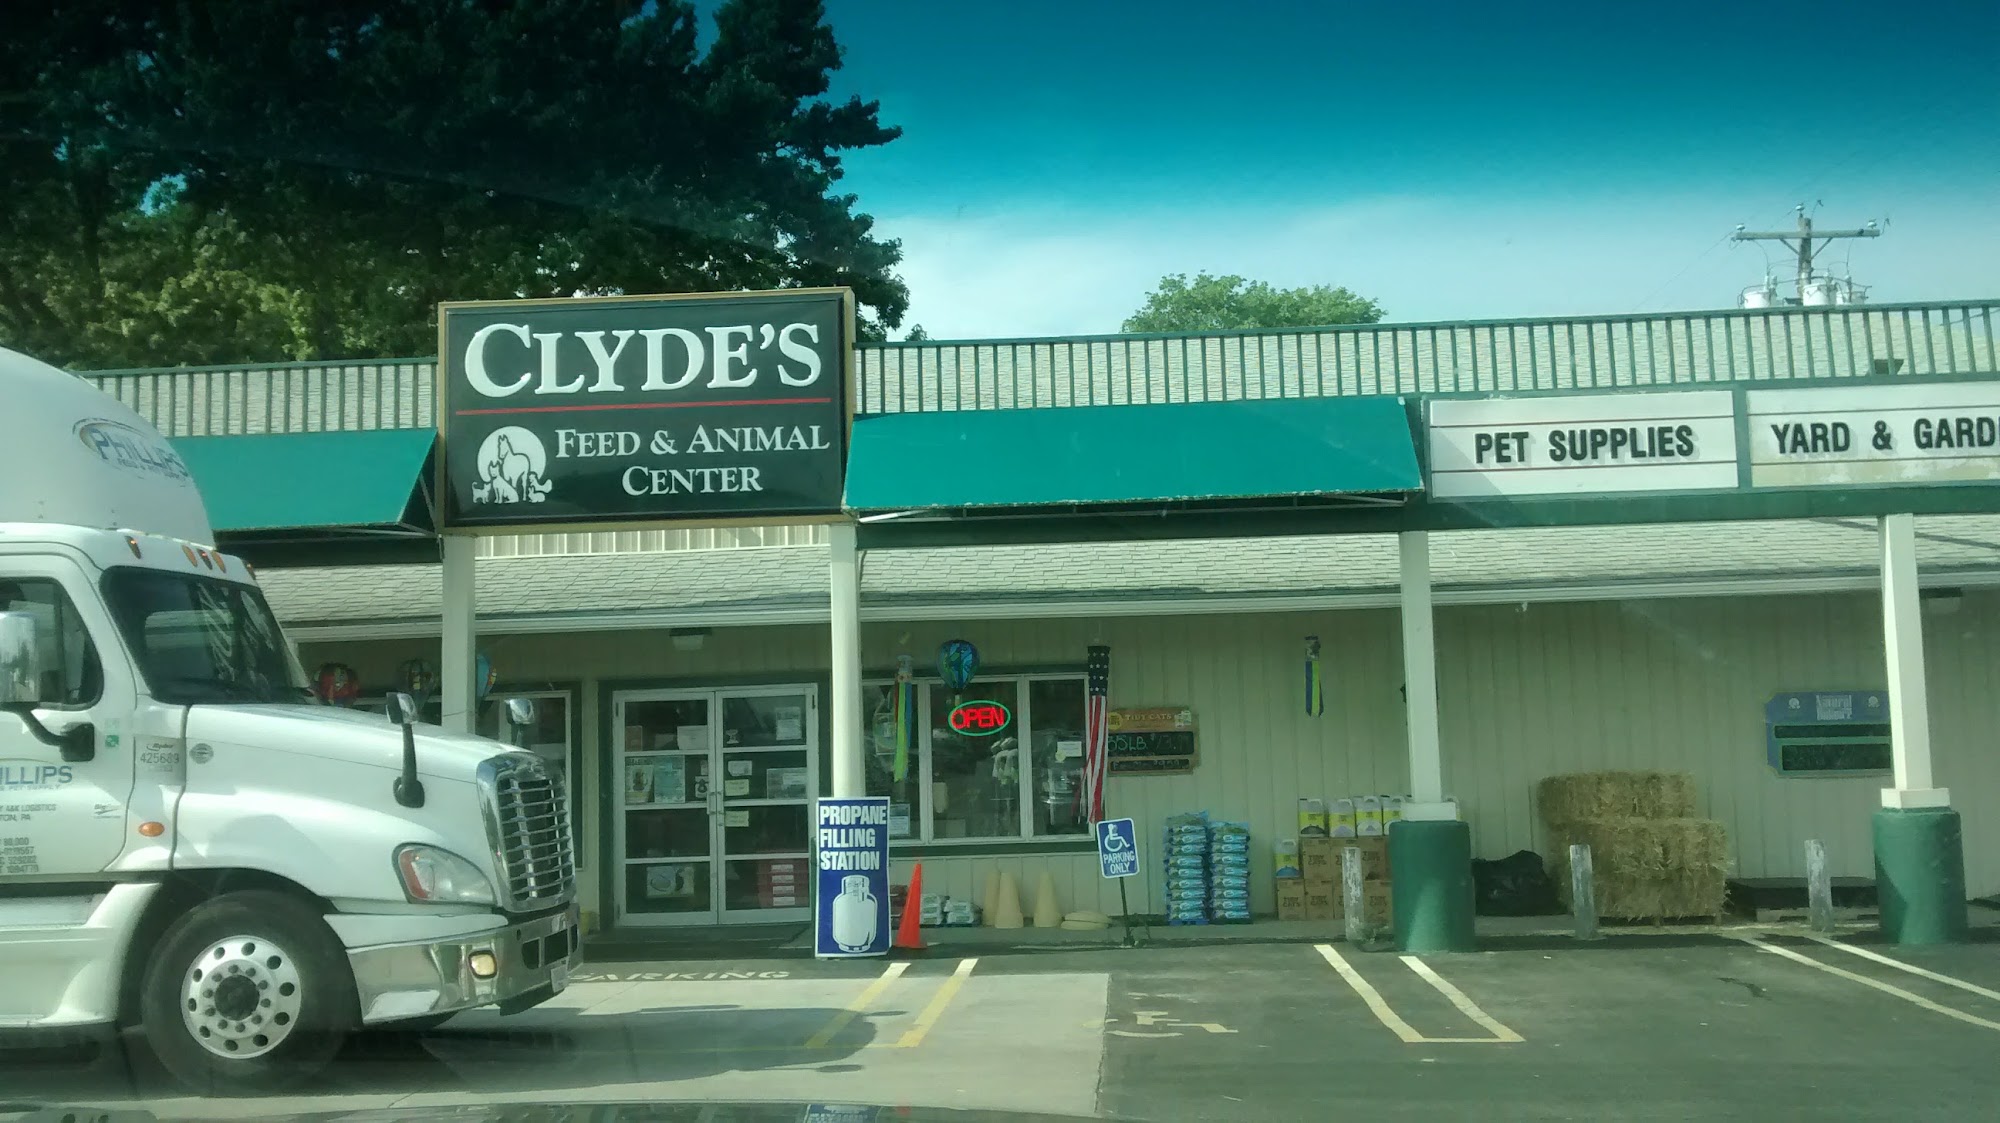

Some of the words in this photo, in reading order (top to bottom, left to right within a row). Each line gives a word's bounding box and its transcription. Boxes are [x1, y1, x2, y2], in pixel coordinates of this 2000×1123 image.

[464, 322, 822, 398] CLYDE'S
[555, 428, 641, 458] FEED
[650, 430, 679, 455] &
[686, 424, 830, 454] ANIMAL
[1475, 431, 1529, 464] PET
[1548, 425, 1695, 462] SUPPLIES
[1771, 422, 1851, 454] YARD
[1872, 420, 1893, 451] &
[1913, 417, 2000, 449] GARD
[622, 466, 764, 496] CENTER
[951, 707, 1005, 730] OPEN
[0, 765, 73, 785] ILLIPS
[819, 805, 887, 825] PROPANE
[820, 828, 876, 848] FILLING
[820, 851, 880, 871] STATION
[1103, 851, 1135, 864] PARKING
[1110, 862, 1130, 874] ONLY
